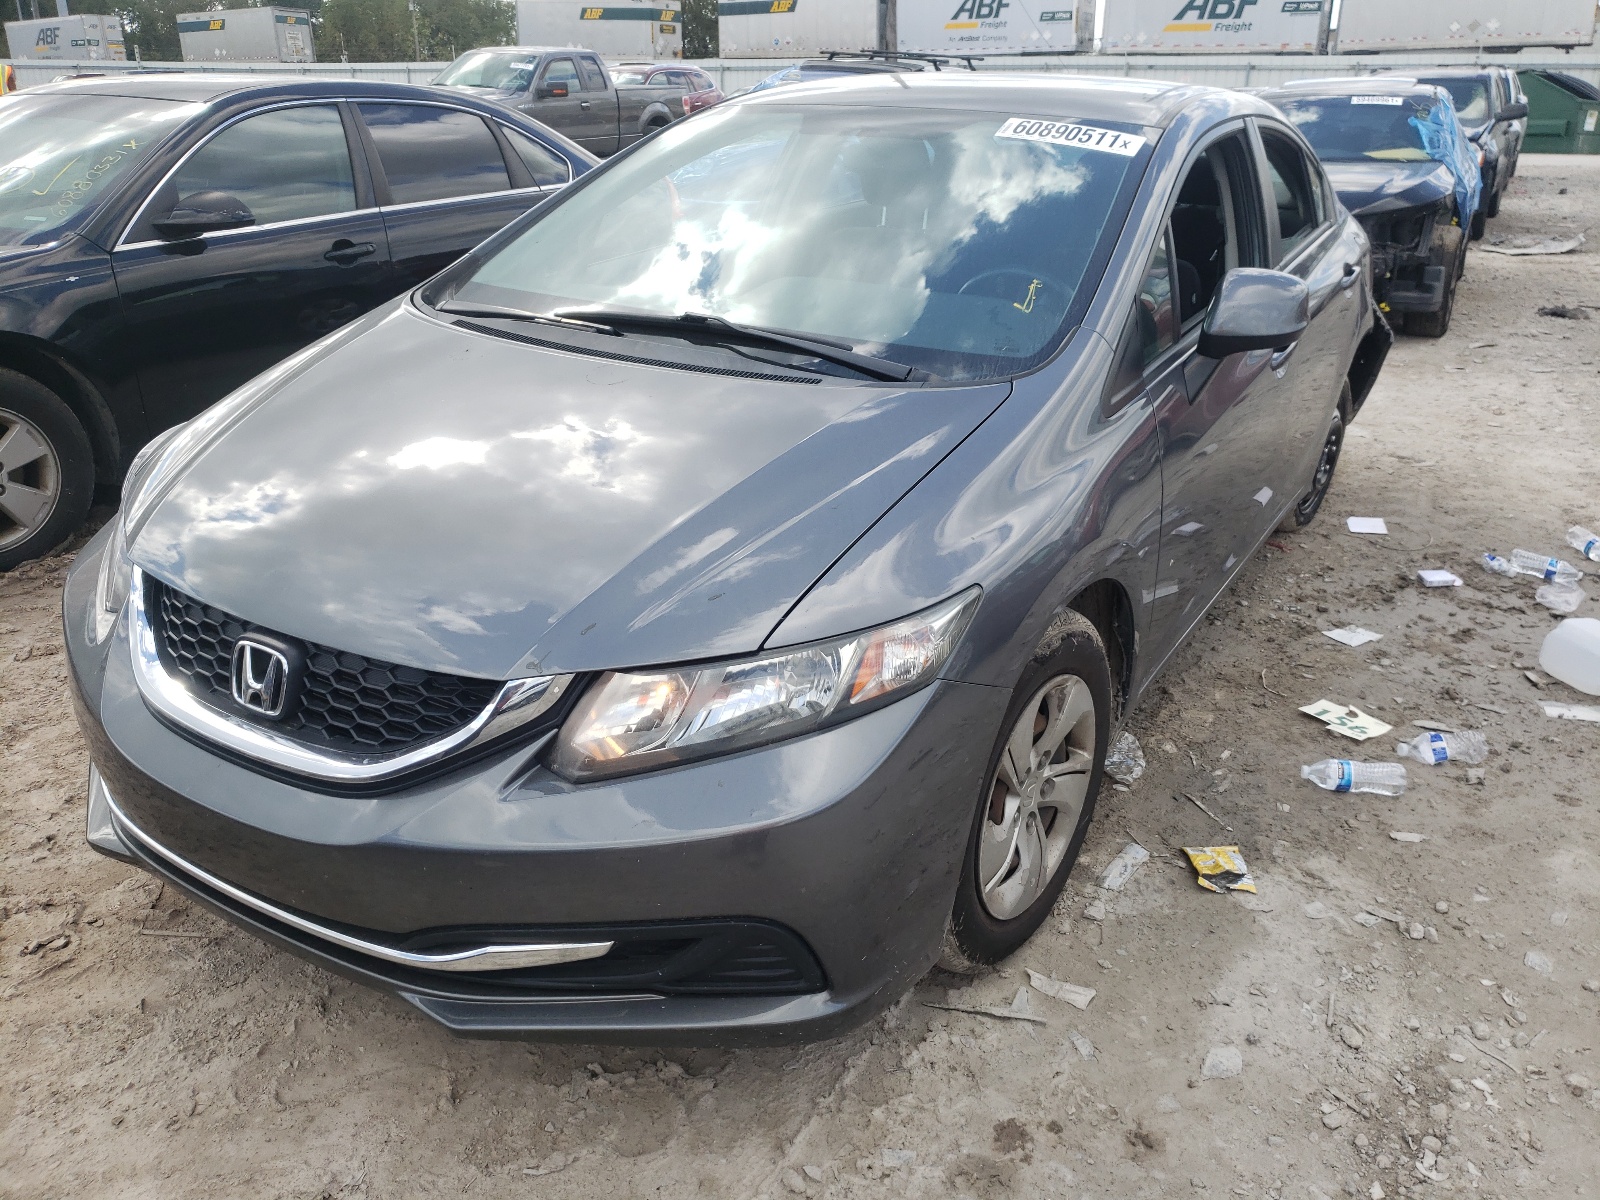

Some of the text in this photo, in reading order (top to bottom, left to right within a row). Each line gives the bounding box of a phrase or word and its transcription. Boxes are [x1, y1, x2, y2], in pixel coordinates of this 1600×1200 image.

[770, 0, 793, 12] ABF
[951, 0, 1010, 20] ABF
[584, 8, 604, 19] ABF
[660, 10, 675, 21] ABF
[209, 20, 222, 30] ABF
[980, 21, 1008, 30] Freight
[1214, 22, 1253, 33] Freight
[36, 27, 60, 46] ABF
